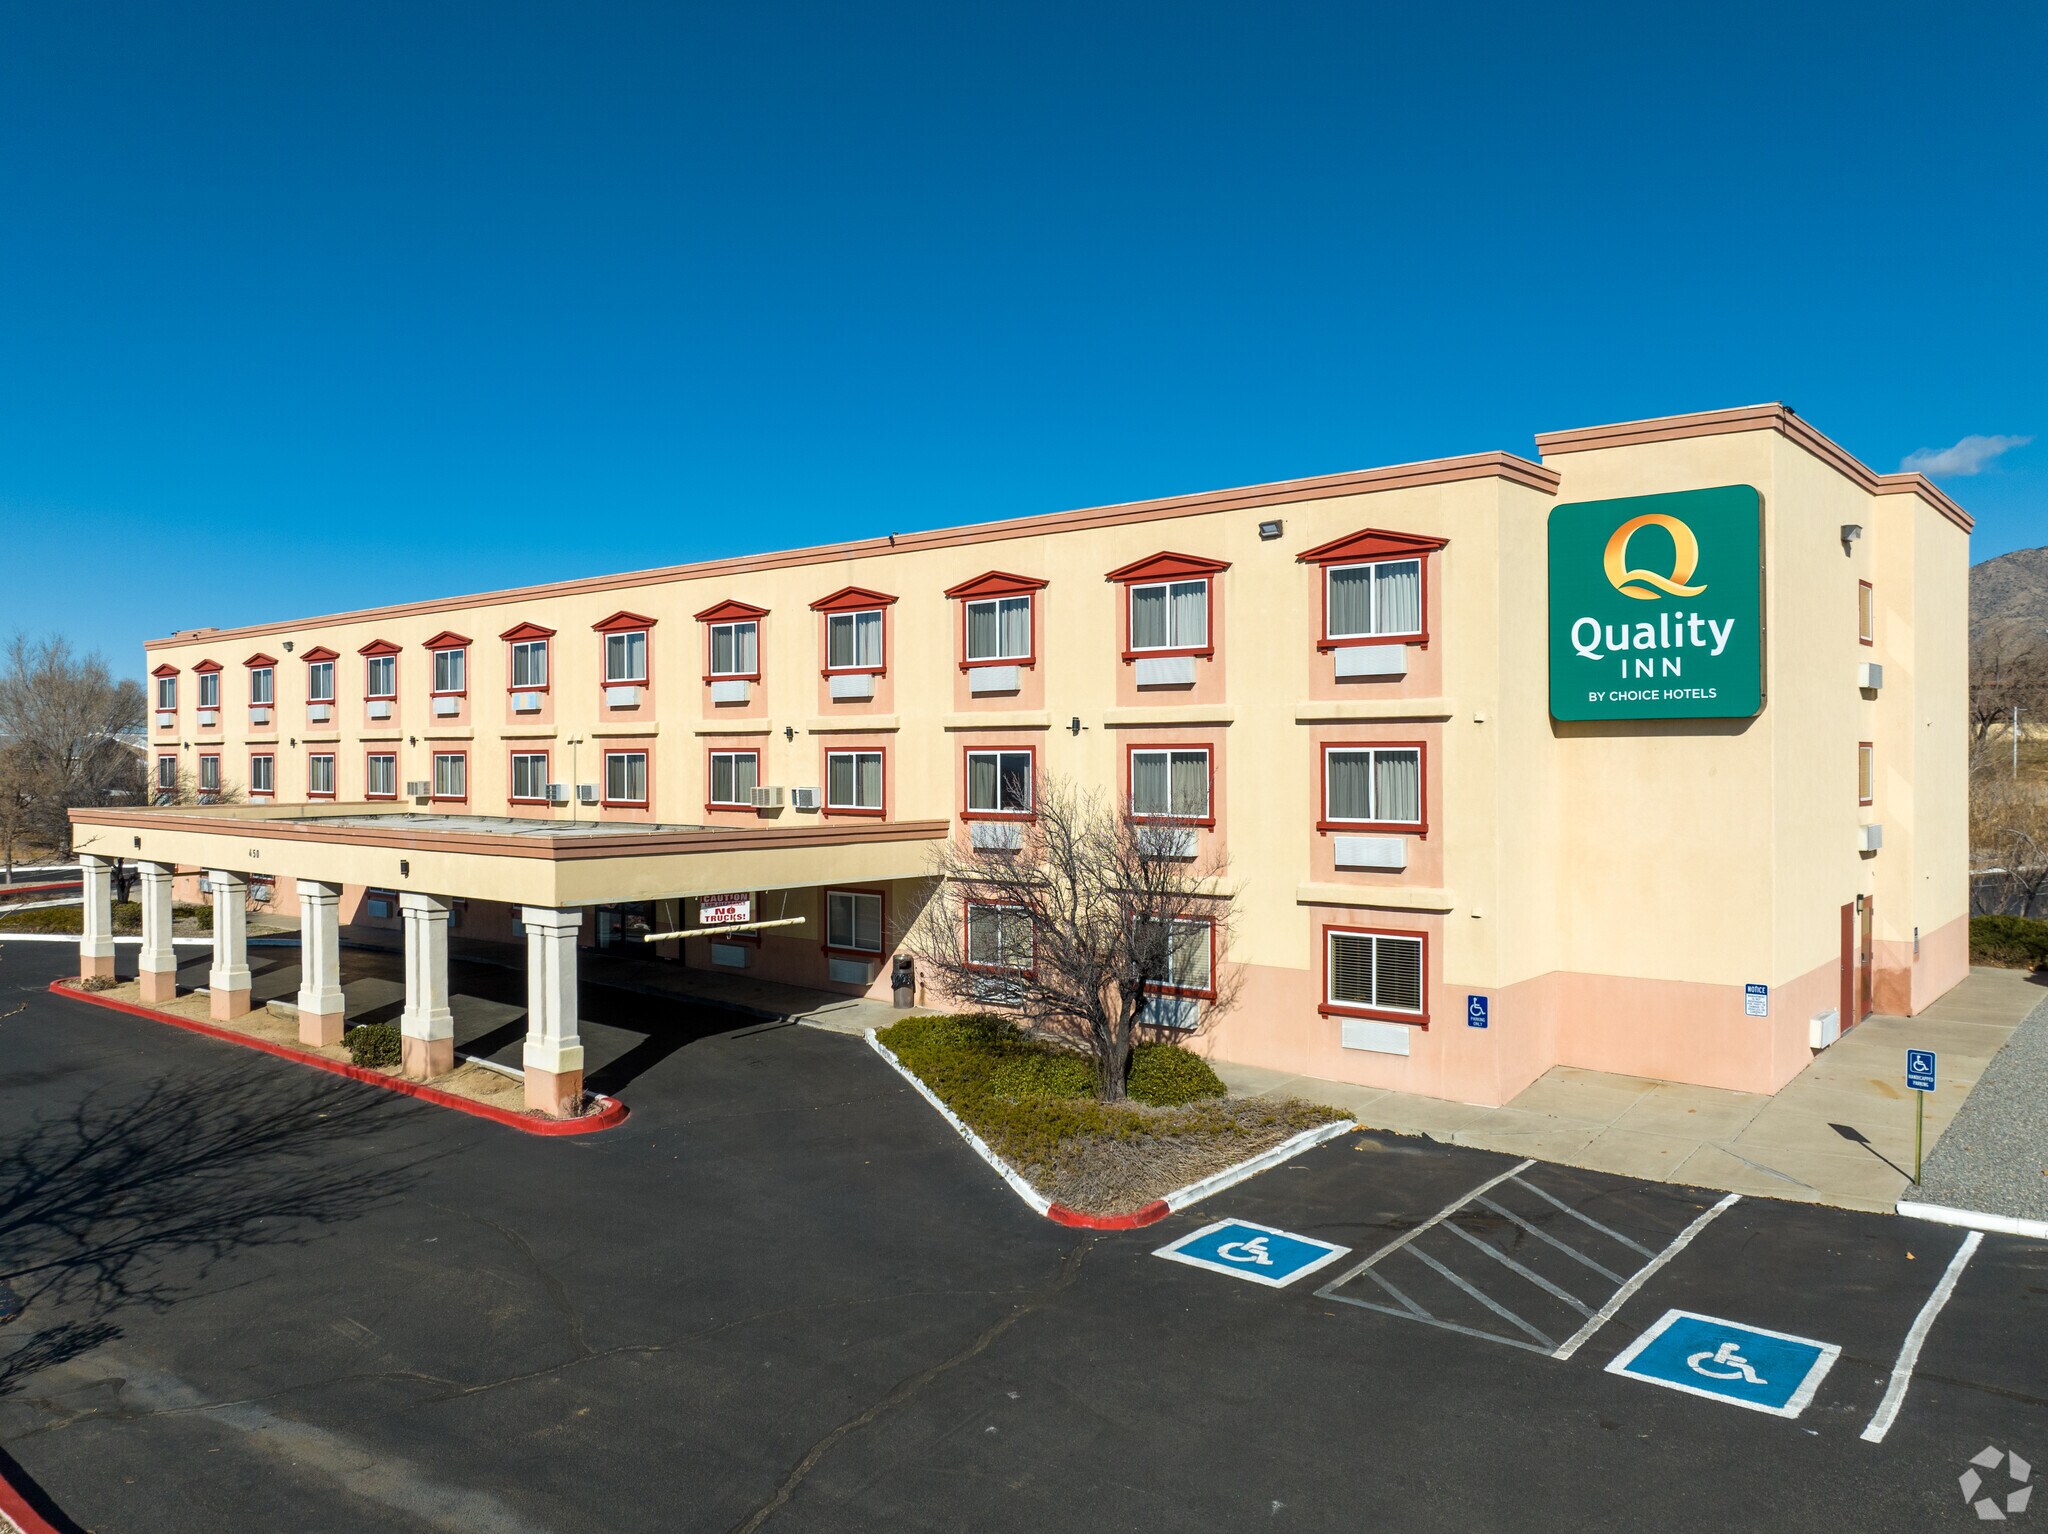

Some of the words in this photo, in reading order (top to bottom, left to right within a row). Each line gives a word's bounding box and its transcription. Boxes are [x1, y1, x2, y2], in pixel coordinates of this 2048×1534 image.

[1603, 513, 1708, 600] Q
[1571, 611, 1735, 660] Quality
[1621, 656, 1681, 679] INN
[1588, 691, 1605, 702] BY
[1609, 689, 1660, 701] CHOICE
[1663, 687, 1717, 700] HOTELS
[248, 848, 260, 859] 450
[703, 893, 748, 903] CAUTION
[715, 906, 736, 915] NO
[705, 913, 746, 922] TRUCKS!
[1747, 985, 1766, 994] NOTICE
[1908, 1074, 1934, 1083] HANDICAPPED
[1912, 1080, 1929, 1088] PARKING
